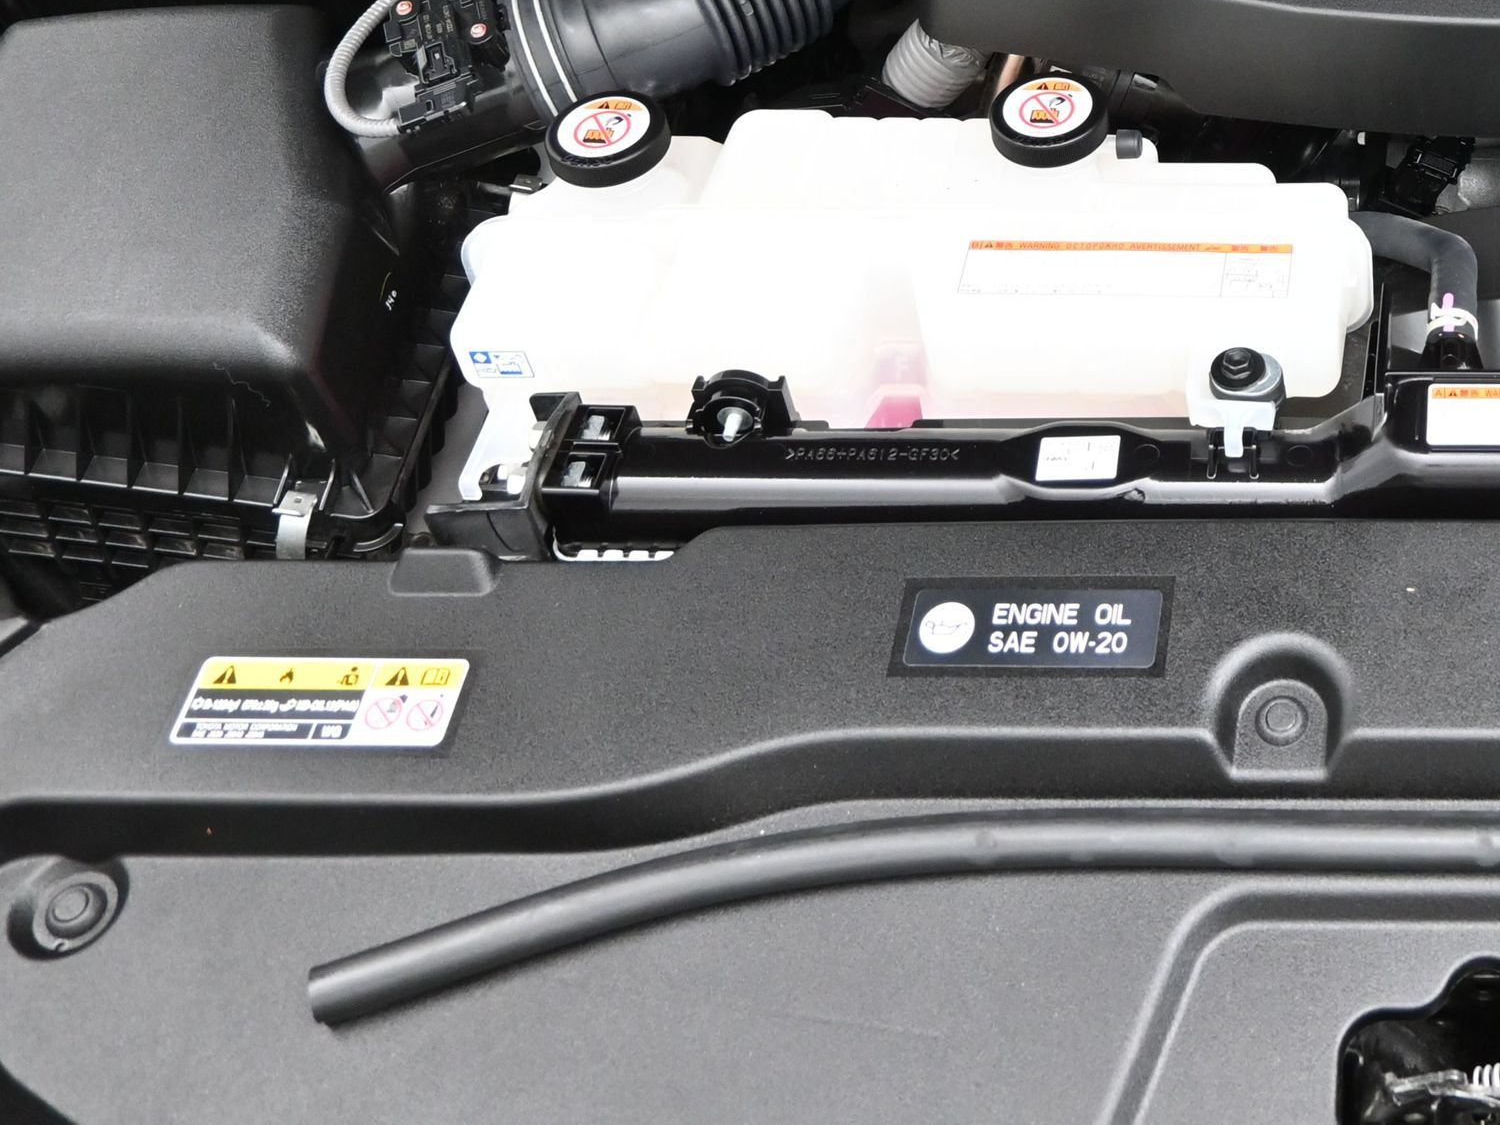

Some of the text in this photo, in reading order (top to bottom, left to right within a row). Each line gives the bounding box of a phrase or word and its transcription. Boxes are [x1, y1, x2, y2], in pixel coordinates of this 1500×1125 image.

[1019, 242, 1060, 250] WARNING
[1129, 243, 1201, 252] AVERTISSEMENT
[992, 603, 1132, 625] ENGINE OIL
[987, 631, 1128, 654] SAE 0W-20
